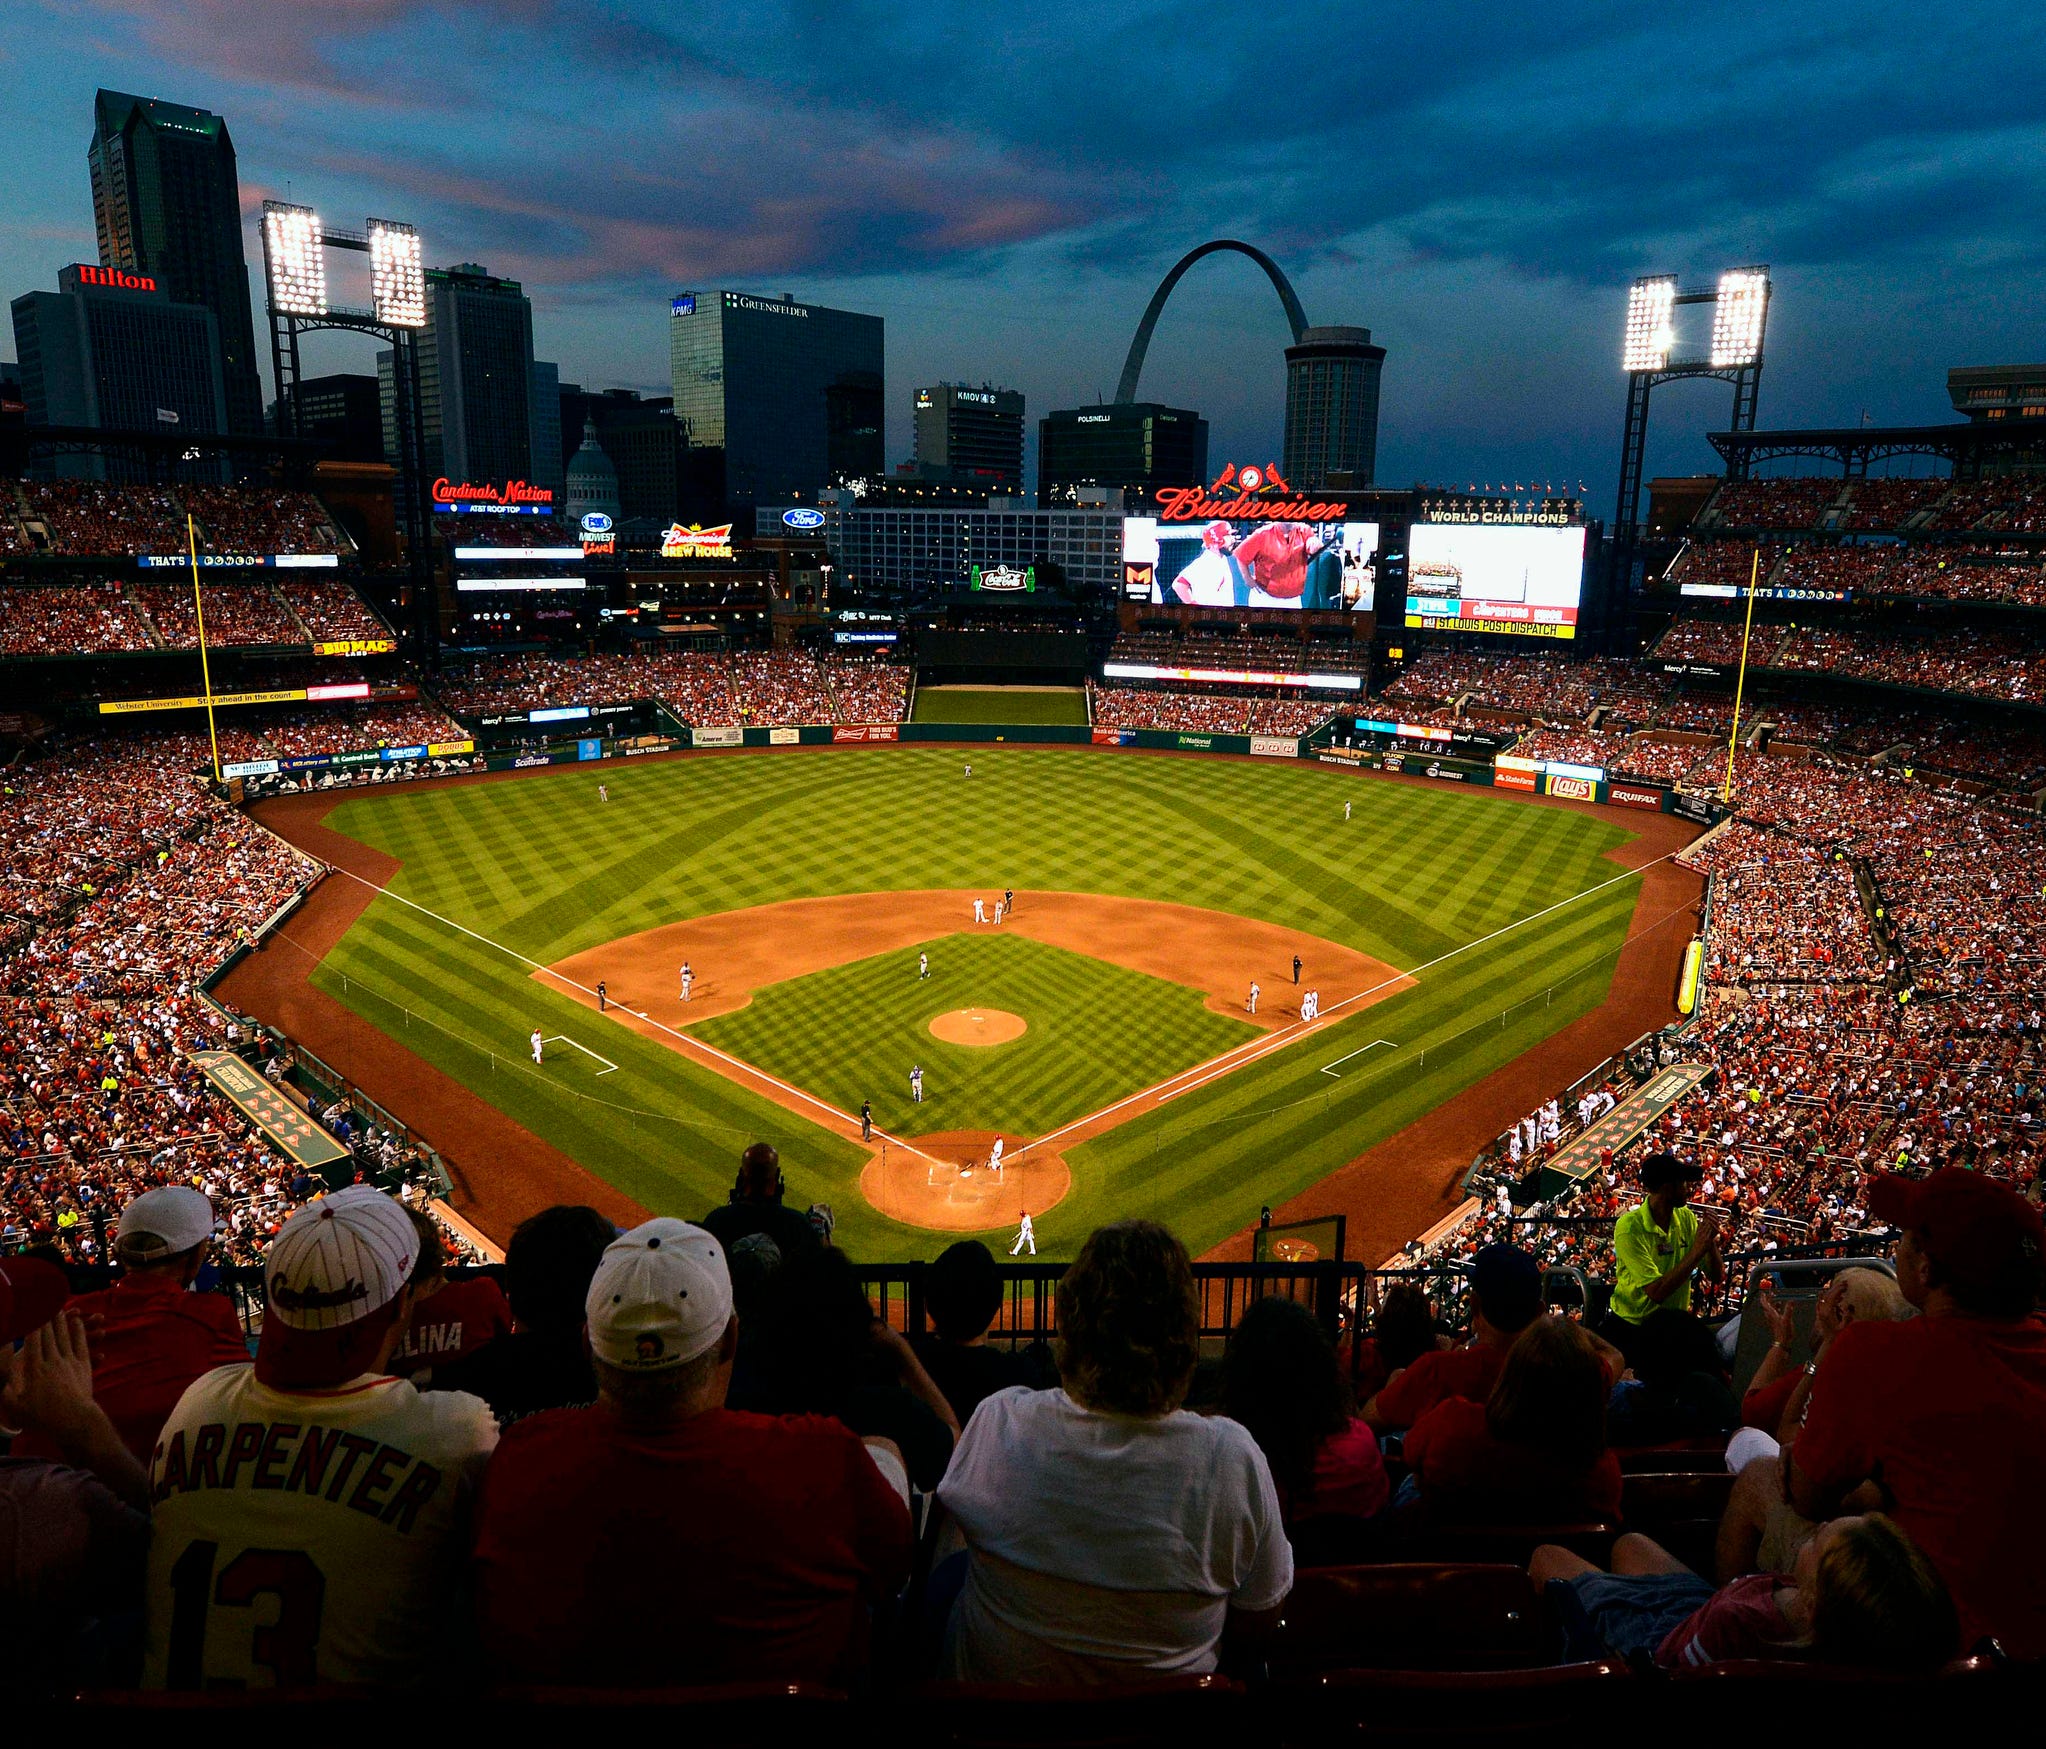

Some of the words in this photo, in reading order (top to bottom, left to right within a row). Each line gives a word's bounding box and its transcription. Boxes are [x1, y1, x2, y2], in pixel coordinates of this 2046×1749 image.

[79, 265, 156, 291] Hilton
[671, 304, 692, 317] KPMG
[740, 297, 808, 318] GREENSFELDER
[958, 391, 979, 401] KMOV
[1078, 415, 1110, 423] POLSINELLI
[433, 477, 498, 503] Cardinals
[498, 480, 552, 504] Nation
[487, 505, 520, 513] ROOFTOP
[1156, 489, 1347, 520] Budweiser
[792, 513, 817, 525] Ford
[1430, 511, 1479, 522] WORLD
[1482, 512, 1568, 523] CHAMPIONS
[579, 532, 616, 541] MIDWEST
[661, 530, 730, 544] Budweiser
[583, 541, 614, 555] Live!
[662, 547, 693, 557] BREW
[696, 547, 732, 557] HOUSE
[148, 556, 185, 566] THAT'S
[1776, 590, 1784, 598] A
[1453, 619, 1480, 630] LOUIS
[1482, 620, 1557, 636] POST-DISPATCH
[323, 641, 350, 655] BIG
[351, 640, 388, 653] MAC
[1664, 665, 1683, 674] Mercy
[115, 702, 145, 710] Webster
[146, 699, 183, 709] University
[197, 698, 215, 706] Sty
[270, 692, 295, 700] count.
[482, 718, 499, 726] Mercy
[1113, 729, 1136, 737] America
[1186, 737, 1211, 745] National
[645, 745, 669, 753] STADIUM
[514, 756, 550, 767] Scottrade
[1382, 752, 1405, 760] STLFORD
[1337, 758, 1360, 767] STADIUM
[1612, 790, 1658, 804] EQUIFAX
[398, 1322, 462, 1358] LINA
[151, 1422, 441, 1533] CARPENTER
[167, 1539, 326, 1691] 13
